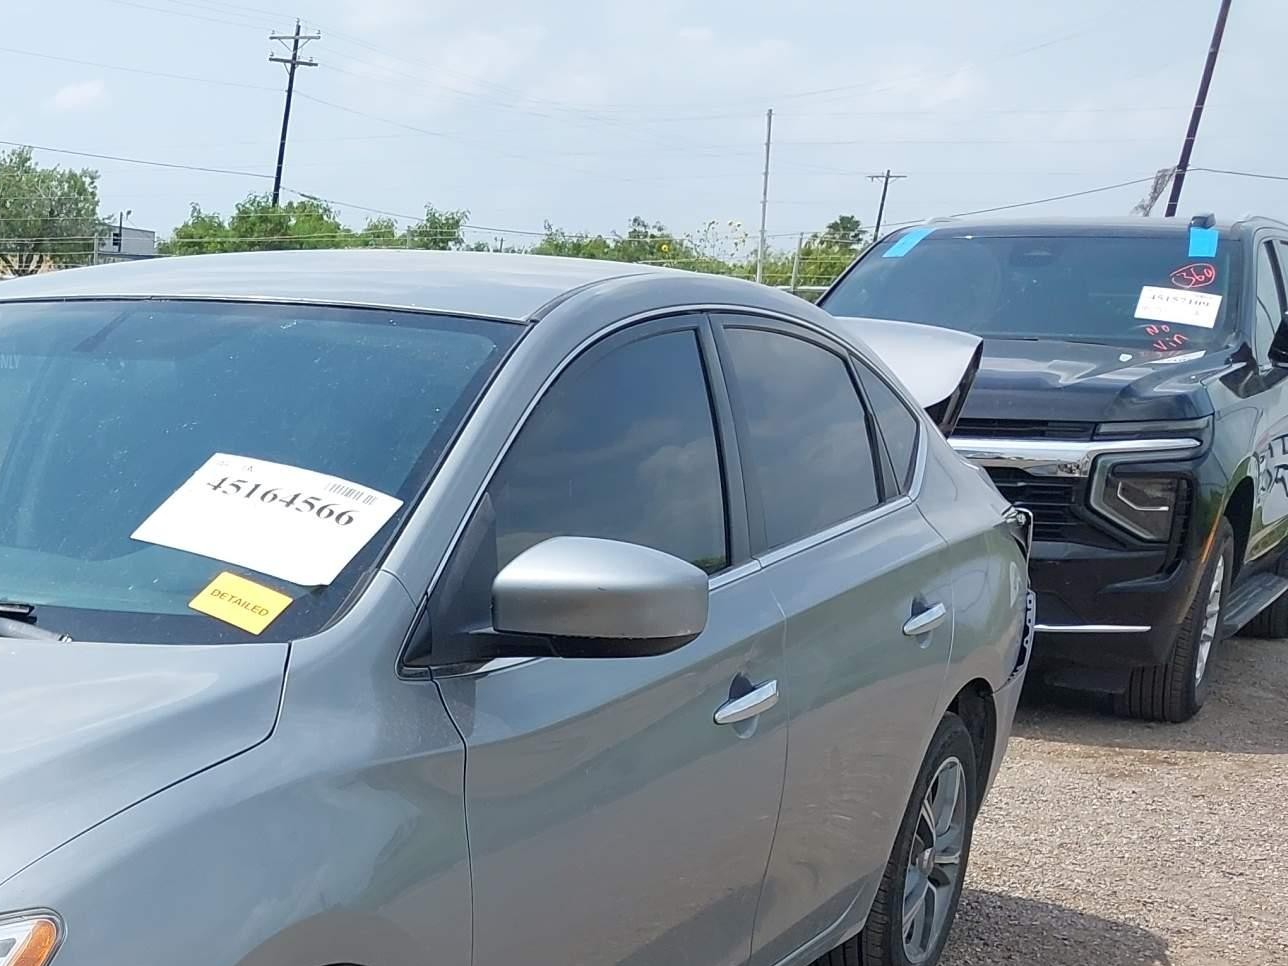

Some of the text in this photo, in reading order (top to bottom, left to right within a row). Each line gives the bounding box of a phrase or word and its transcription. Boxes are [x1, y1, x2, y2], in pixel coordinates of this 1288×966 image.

[1175, 267, 1213, 288] 360
[207, 476, 360, 527] 45164566
[210, 588, 269, 617] DETAILED
